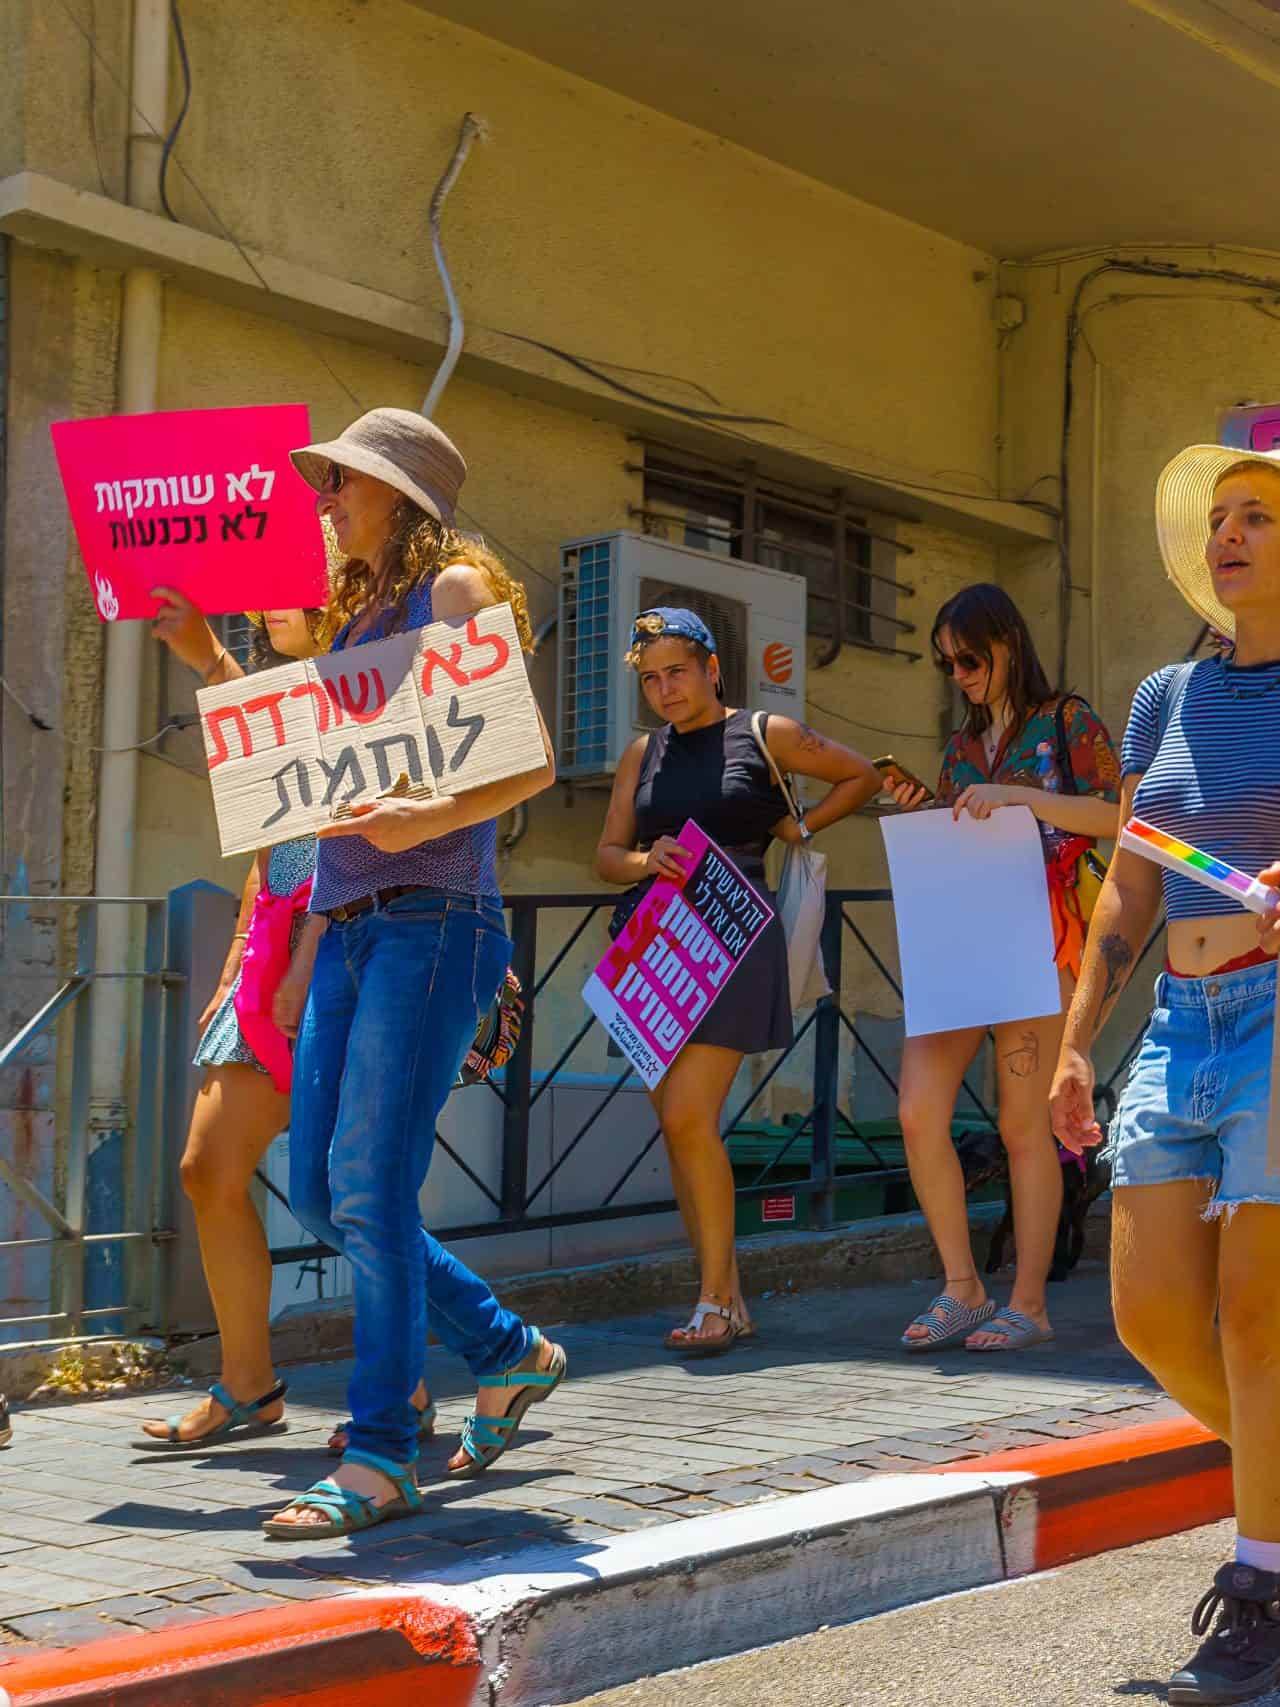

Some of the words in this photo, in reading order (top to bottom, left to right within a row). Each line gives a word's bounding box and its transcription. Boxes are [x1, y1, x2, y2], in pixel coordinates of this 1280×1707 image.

[94, 473, 214, 519] שותקות
[224, 463, 275, 503] לא
[109, 514, 208, 550] נכנעות
[219, 505, 268, 542] לא
[422, 616, 510, 696] לא
[203, 667, 387, 770] שורדת
[260, 694, 485, 829] לוחמת
[695, 881, 711, 906] לי
[705, 852, 735, 895] שינוי
[702, 898, 728, 933] אין
[726, 883, 750, 913] לא
[741, 903, 764, 932] זה
[658, 894, 730, 988] ביטחון
[722, 922, 747, 957] אם
[642, 934, 708, 1021] רווחה
[613, 962, 685, 1051] שוויון
